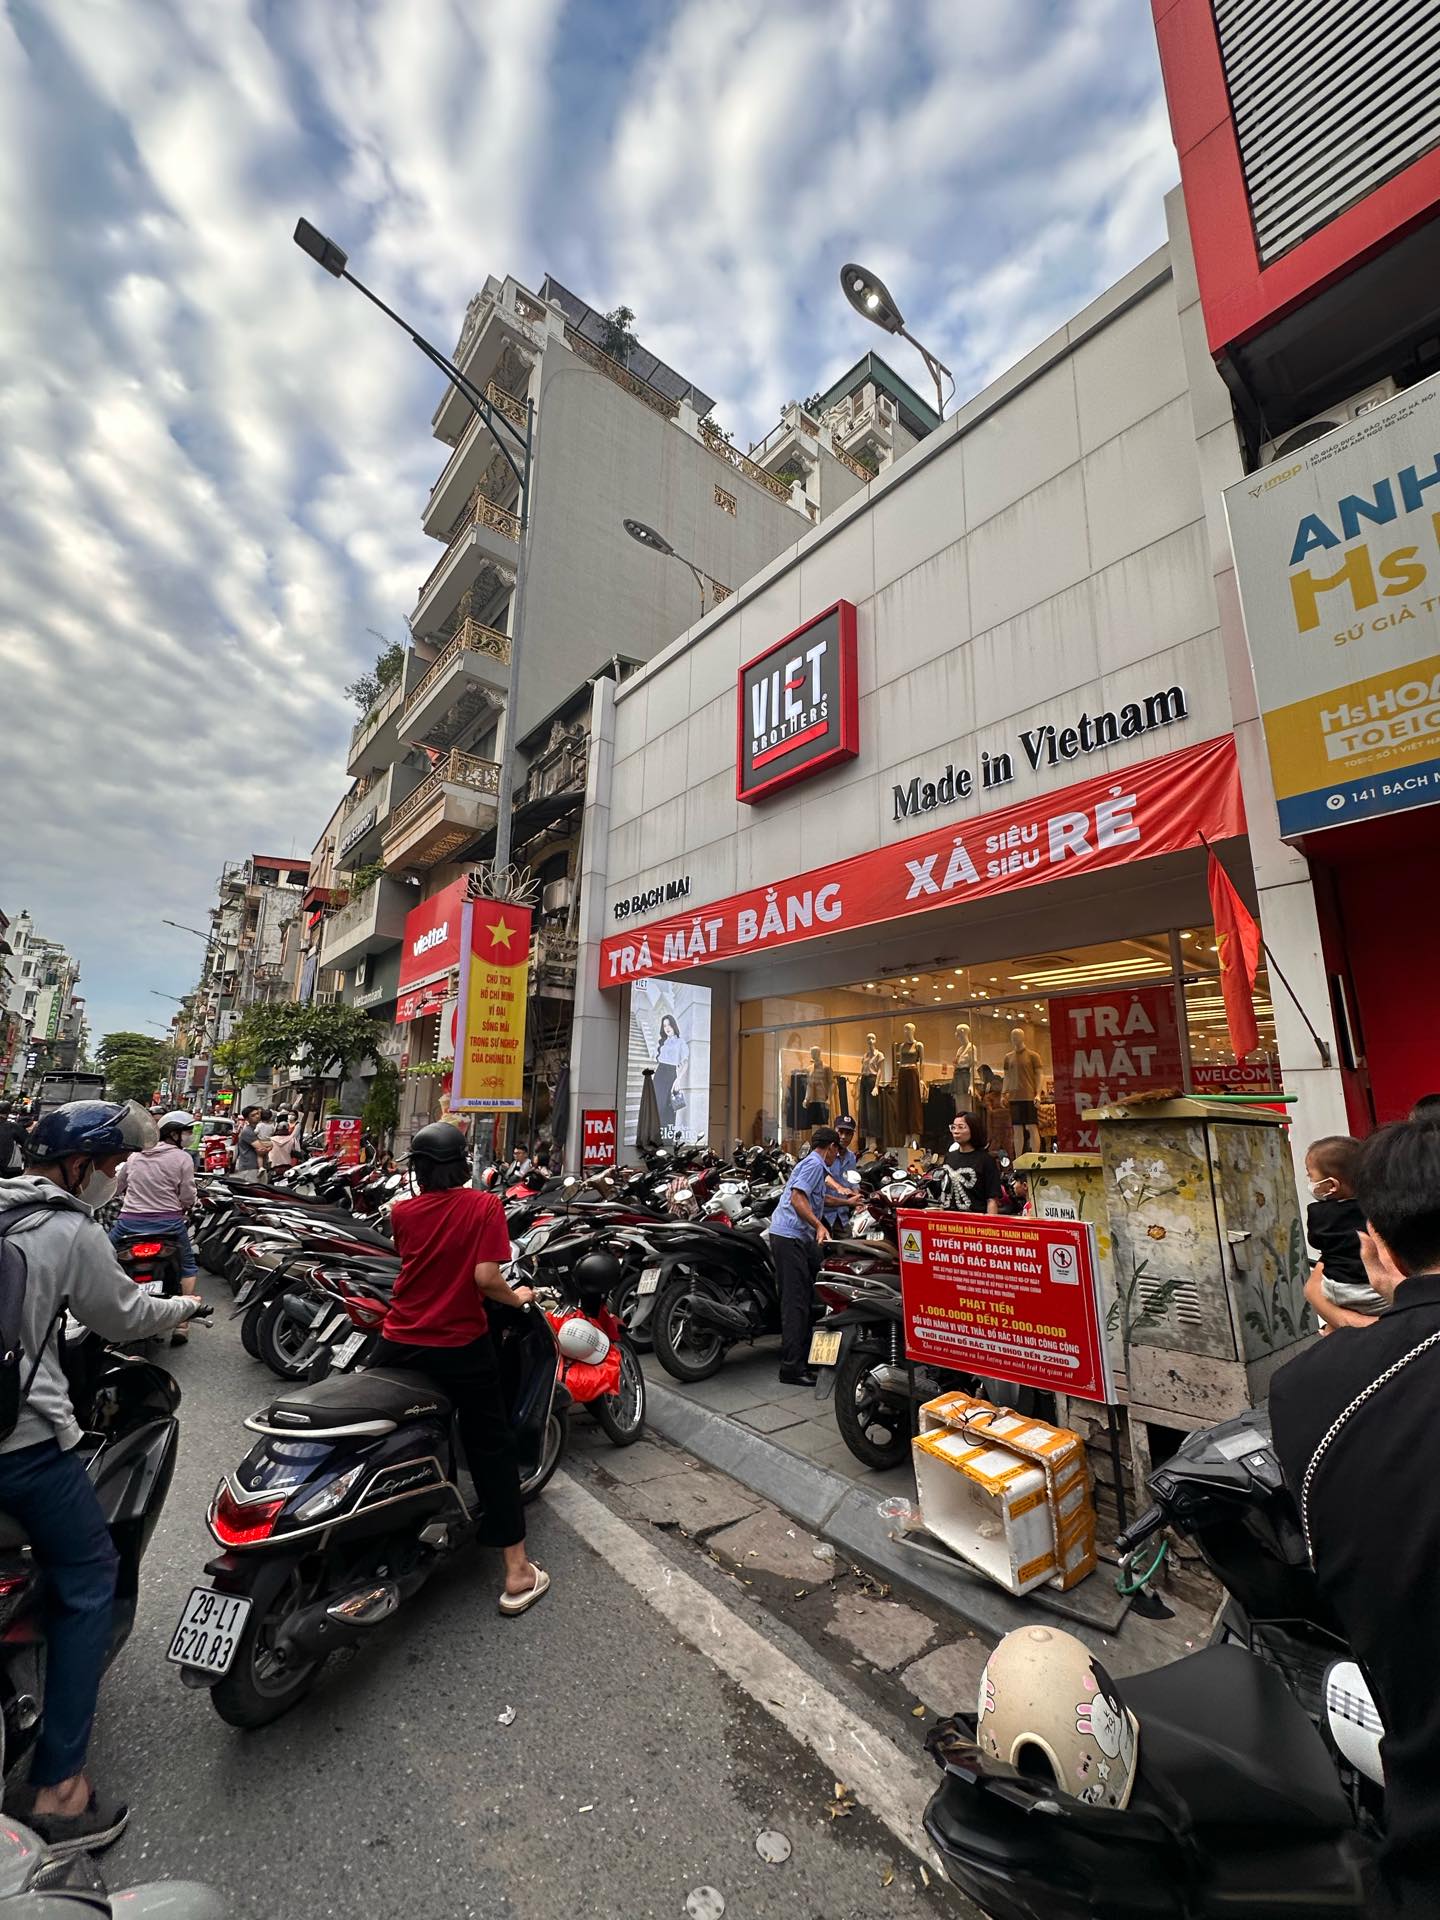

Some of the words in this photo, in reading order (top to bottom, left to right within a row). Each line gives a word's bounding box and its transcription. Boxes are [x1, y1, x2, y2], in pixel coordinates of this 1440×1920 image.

[1333, 622, 1365, 647] SỨ
[752, 701, 828, 754] BROTHERS
[892, 764, 974, 822] Made
[981, 751, 1015, 790] in
[1018, 685, 1189, 771] Vietnam
[1351, 788, 1376, 802] 141
[1382, 774, 1429, 796] BẠCH
[985, 823, 1040, 854] SIÊU
[1047, 786, 1141, 863] RẺ
[905, 837, 981, 900] XẢ
[986, 848, 1040, 879] SIÊU
[613, 899, 630, 919] 139
[631, 885, 664, 914] BẠCH
[666, 875, 690, 901] MAI
[413, 922, 448, 957] viettel
[608, 935, 653, 977] TRẢ
[662, 917, 724, 965] MẶT
[737, 883, 843, 945] BẰNG
[489, 988, 500, 1000] CHÍ
[1069, 995, 1156, 1039] TRẢ
[471, 1049, 484, 1063] CỦA
[1073, 1040, 1157, 1085] MẶT
[1195, 1067, 1282, 1083] WELCOME
[585, 1116, 614, 1134] TRẢ
[585, 1142, 614, 1161] MẶT
[1001, 1229, 1021, 1239] THANH
[931, 1237, 961, 1250] TUYẾN
[963, 1240, 983, 1252] PHỐ
[985, 1243, 1013, 1256] BẠCH
[1016, 1246, 1037, 1259] MAI
[928, 1250, 950, 1263] CẤM
[967, 1255, 987, 1268] RÁC
[989, 1259, 1011, 1270] BAN
[1013, 1261, 1043, 1274] NGÀY
[959, 1297, 987, 1312] PHẠT
[976, 1312, 999, 1327] ĐẾN
[938, 1334, 956, 1343] GIAN
[968, 1338, 985, 1349] RÁC
[997, 1330, 1012, 1342] RÁC
[1012, 1333, 1023, 1345] TẠI
[1024, 1336, 1037, 1347] NƠI
[1038, 1337, 1058, 1350] CÔNG
[1059, 1341, 1080, 1355] CỘNG
[190, 1593, 241, 1632] 29-L1
[173, 1626, 233, 1668] 620.83
